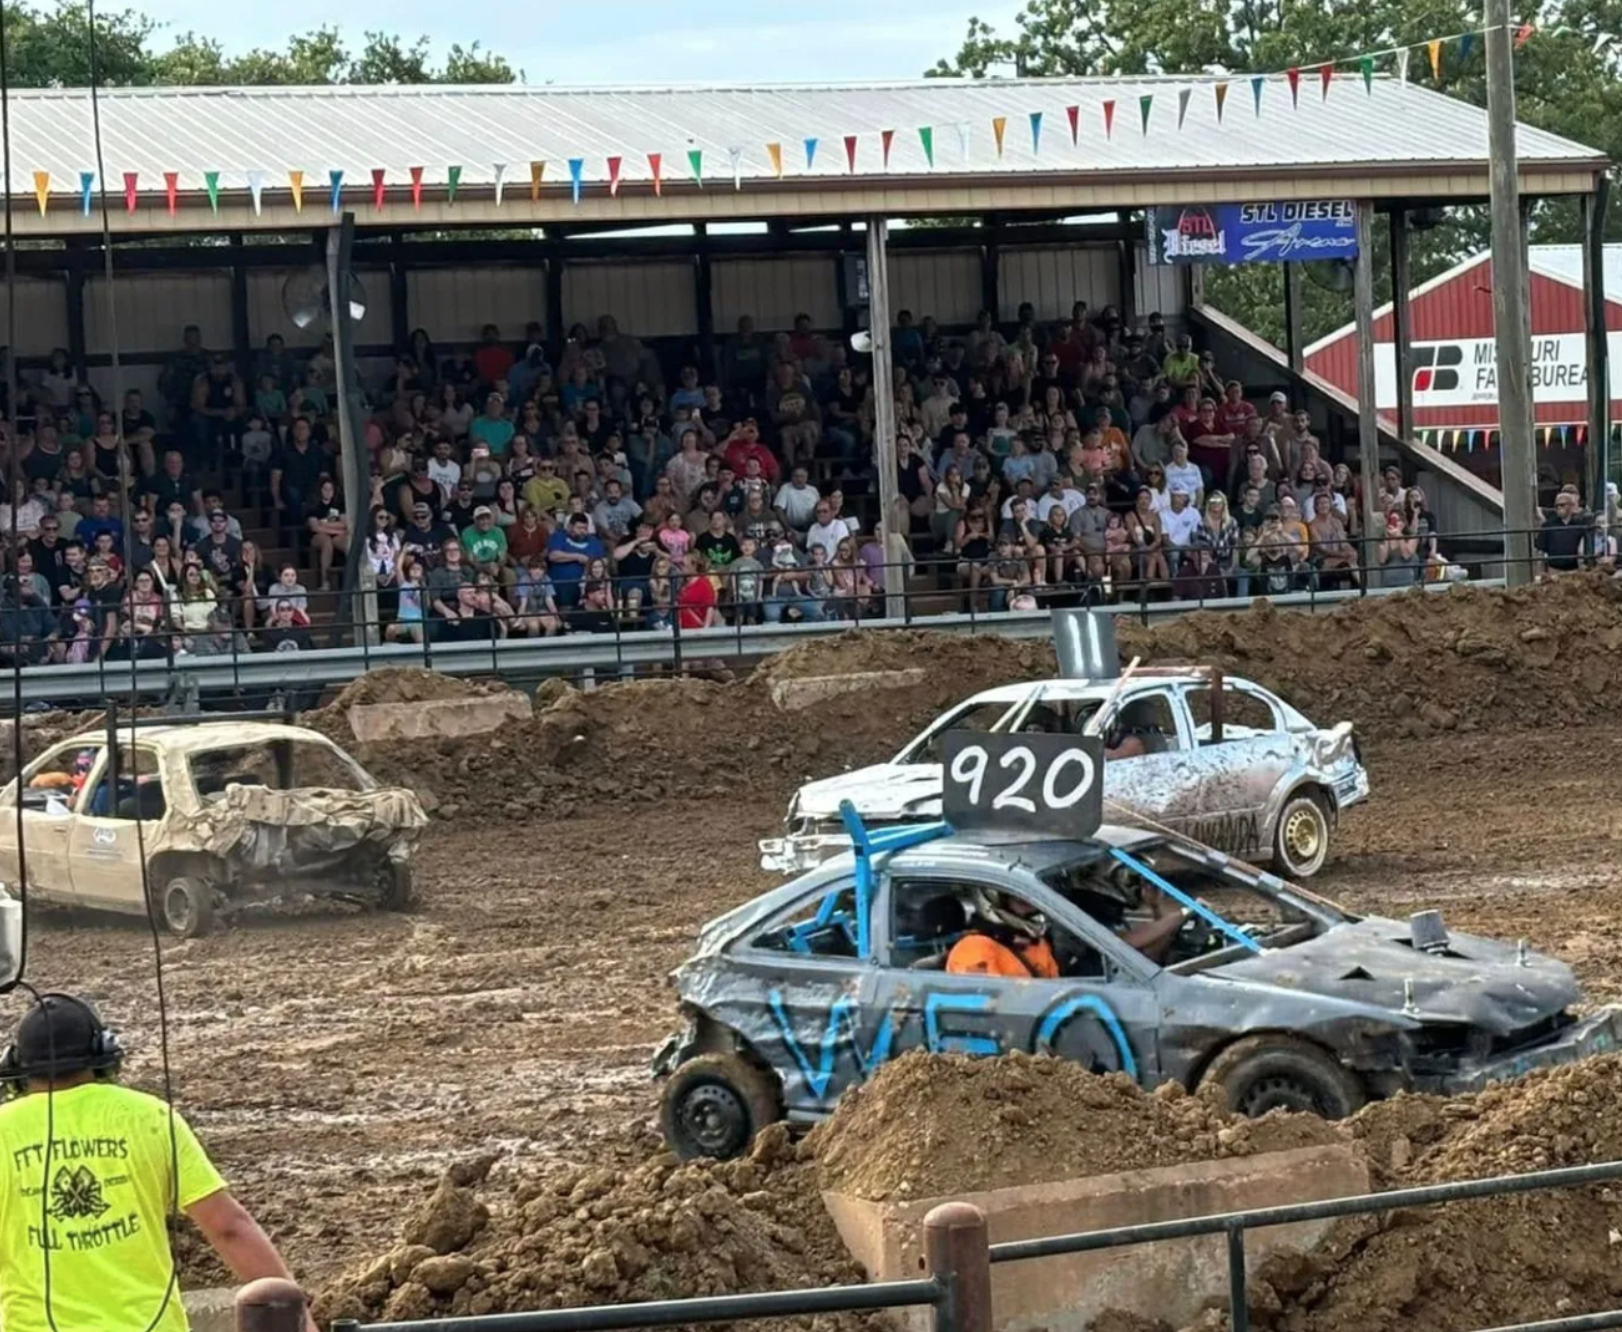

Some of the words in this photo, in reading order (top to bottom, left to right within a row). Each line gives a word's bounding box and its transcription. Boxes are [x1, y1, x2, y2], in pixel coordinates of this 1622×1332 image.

[1180, 216, 1214, 234] STL
[1240, 203, 1276, 224] STL
[1282, 200, 1354, 221] DIESEL
[1474, 340, 1560, 364] MIURI
[951, 745, 1094, 813] 920
[14, 1144, 44, 1172] FFT
[52, 1138, 129, 1160] FLOWERS
[66, 1213, 141, 1251] THROTTLE
